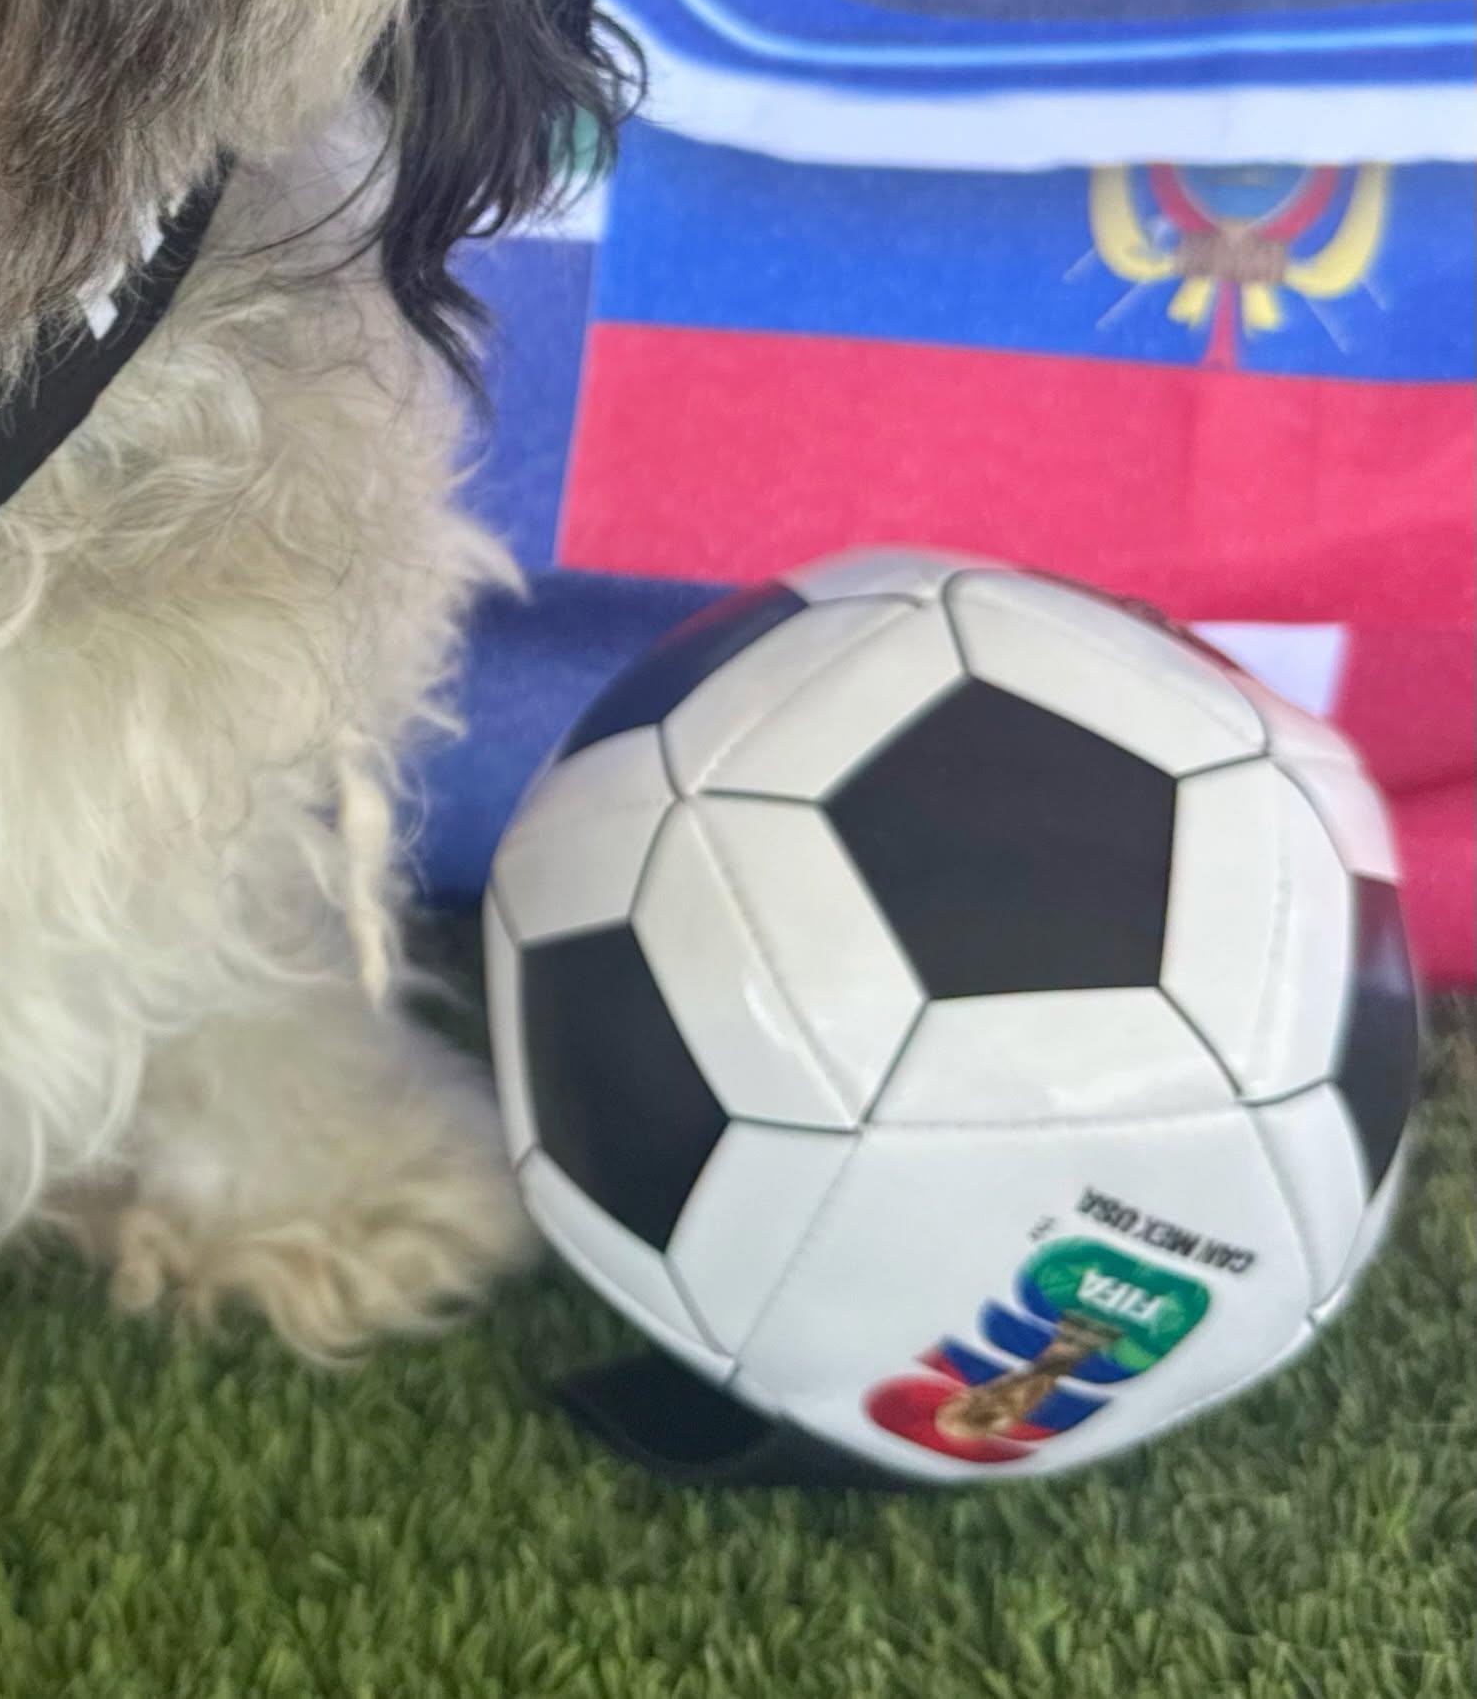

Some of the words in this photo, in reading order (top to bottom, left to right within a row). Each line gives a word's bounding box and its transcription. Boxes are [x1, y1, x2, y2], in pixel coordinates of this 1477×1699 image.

[1075, 1186, 1140, 1233] USA
[1134, 1214, 1202, 1257] MEX
[1196, 1238, 1257, 1274] CAN
[1076, 1268, 1164, 1321] FIFA
